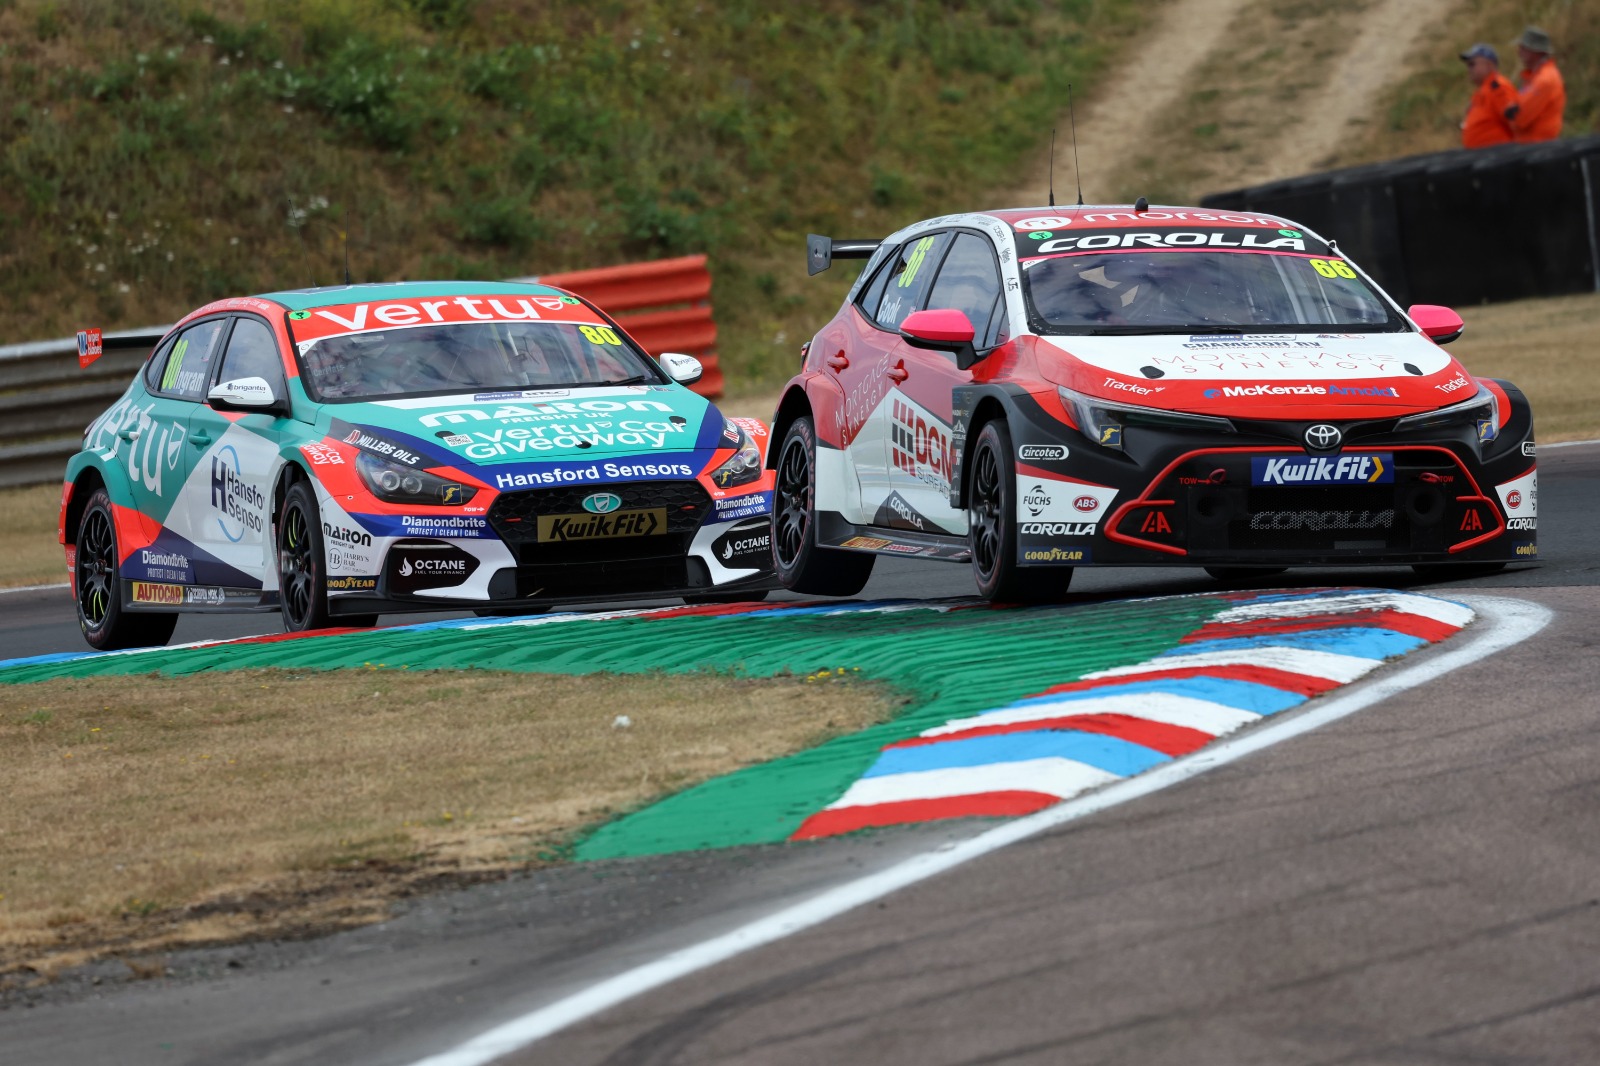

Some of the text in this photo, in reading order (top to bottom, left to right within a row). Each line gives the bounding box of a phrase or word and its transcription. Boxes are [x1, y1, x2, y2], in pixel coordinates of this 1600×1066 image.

[1037, 233, 1306, 253] COROLLA
[897, 237, 934, 287] 66
[1309, 259, 1357, 279] 66
[579, 325, 622, 345] 80
[1151, 351, 1400, 365] MORTGAGE
[1183, 359, 1389, 374] SYNERGY
[835, 353, 889, 428] MORTGAGE
[1103, 377, 1153, 396] Tracker
[1222, 384, 1327, 398] McKenzie
[1328, 384, 1394, 398] Arnold
[1434, 377, 1469, 394] Tracker
[501, 413, 578, 425] FREIGHT
[842, 381, 882, 445] SYNERGY
[618, 420, 686, 434] Car
[356, 434, 421, 465] MILLERS OILS
[464, 431, 666, 459] Giveaway
[1024, 447, 1061, 458] zircotec
[496, 463, 693, 488] Hansford Sensors
[715, 495, 766, 511] Diamondbrite
[1023, 495, 1051, 505] FUCHS
[1076, 499, 1096, 508] ABS
[402, 515, 487, 528] Diamondbrite
[890, 496, 924, 531] COROLLA
[1250, 509, 1396, 531] COROLLA
[406, 527, 480, 537] PROTECT CLEAN CARE
[1021, 523, 1097, 537] COROLLA
[735, 536, 770, 551] OCTANE
[142, 550, 189, 569] Diamondbrite
[410, 560, 466, 570] OCTANE
[136, 583, 182, 604] AUTOCAR
